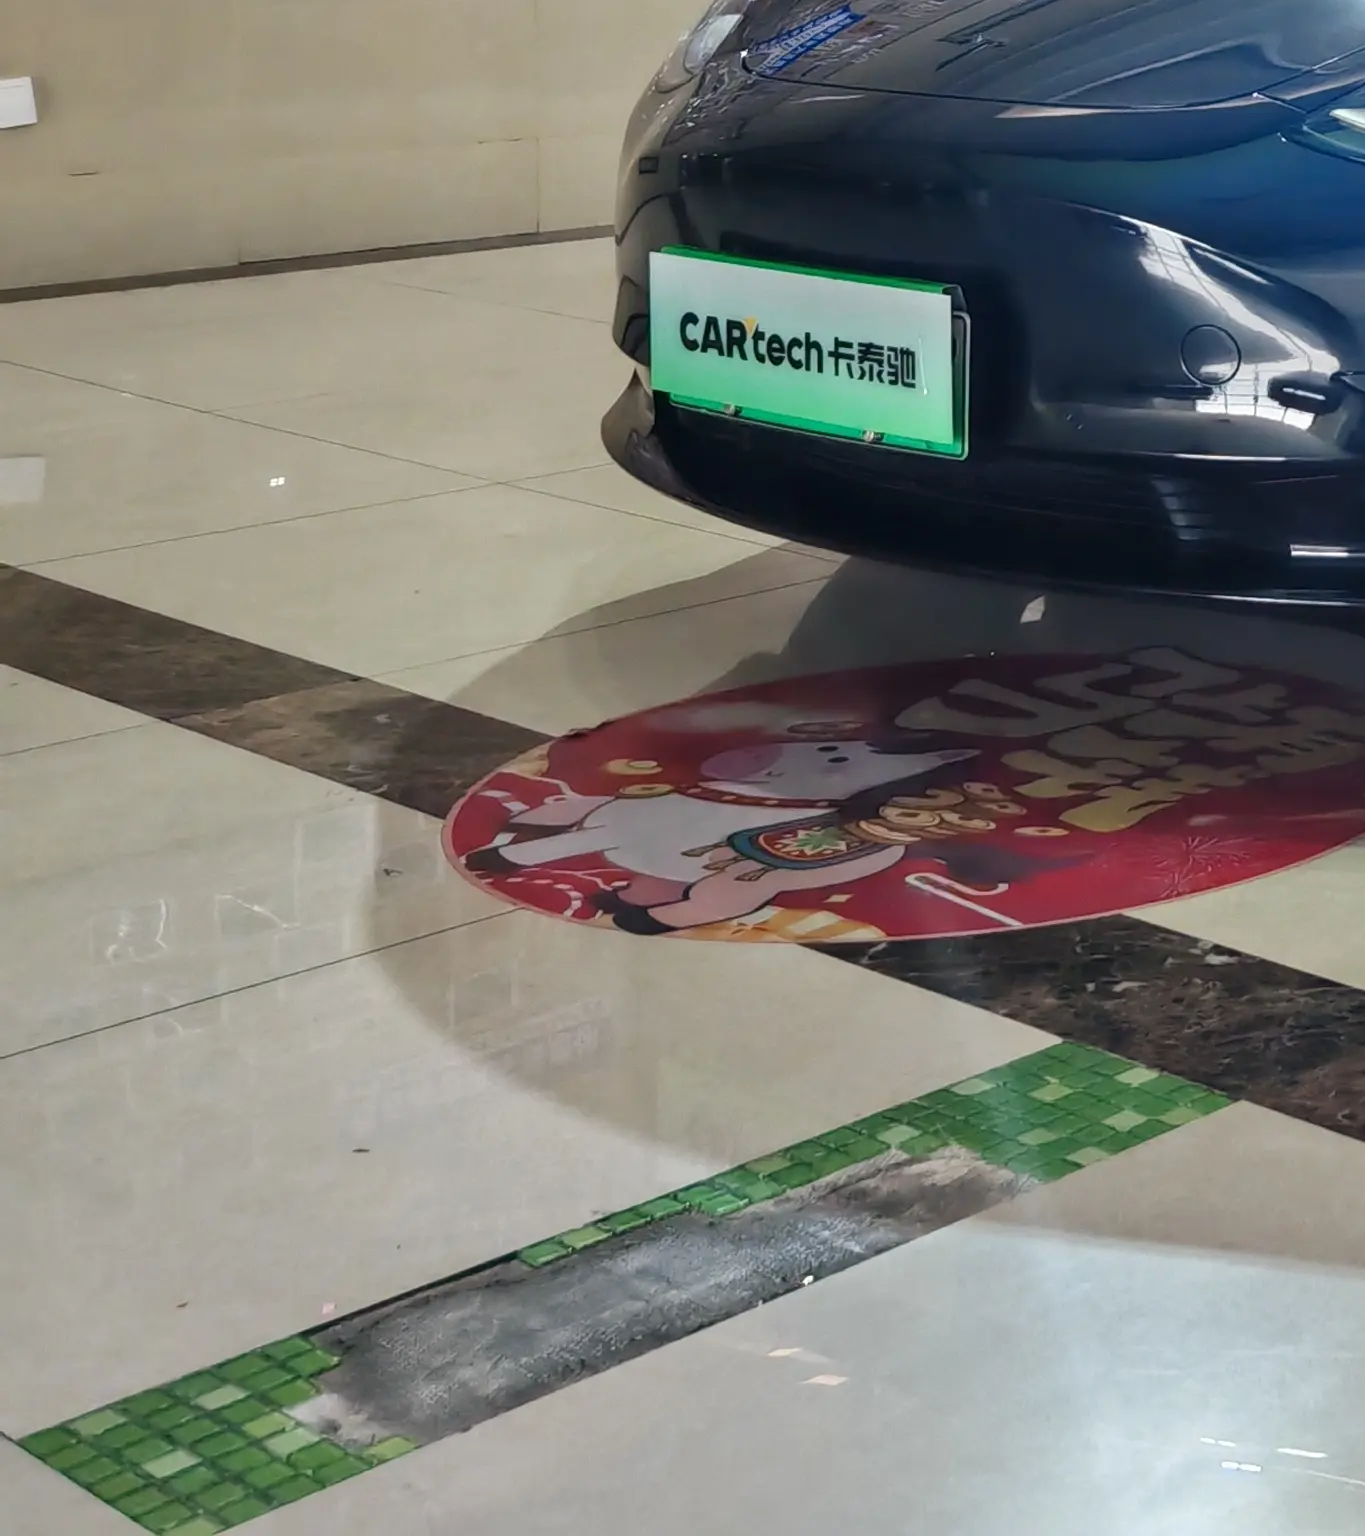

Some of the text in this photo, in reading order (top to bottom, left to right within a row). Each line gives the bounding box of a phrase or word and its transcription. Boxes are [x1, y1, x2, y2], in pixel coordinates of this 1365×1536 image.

[680, 312, 917, 389] CARtech 卡泰驰
